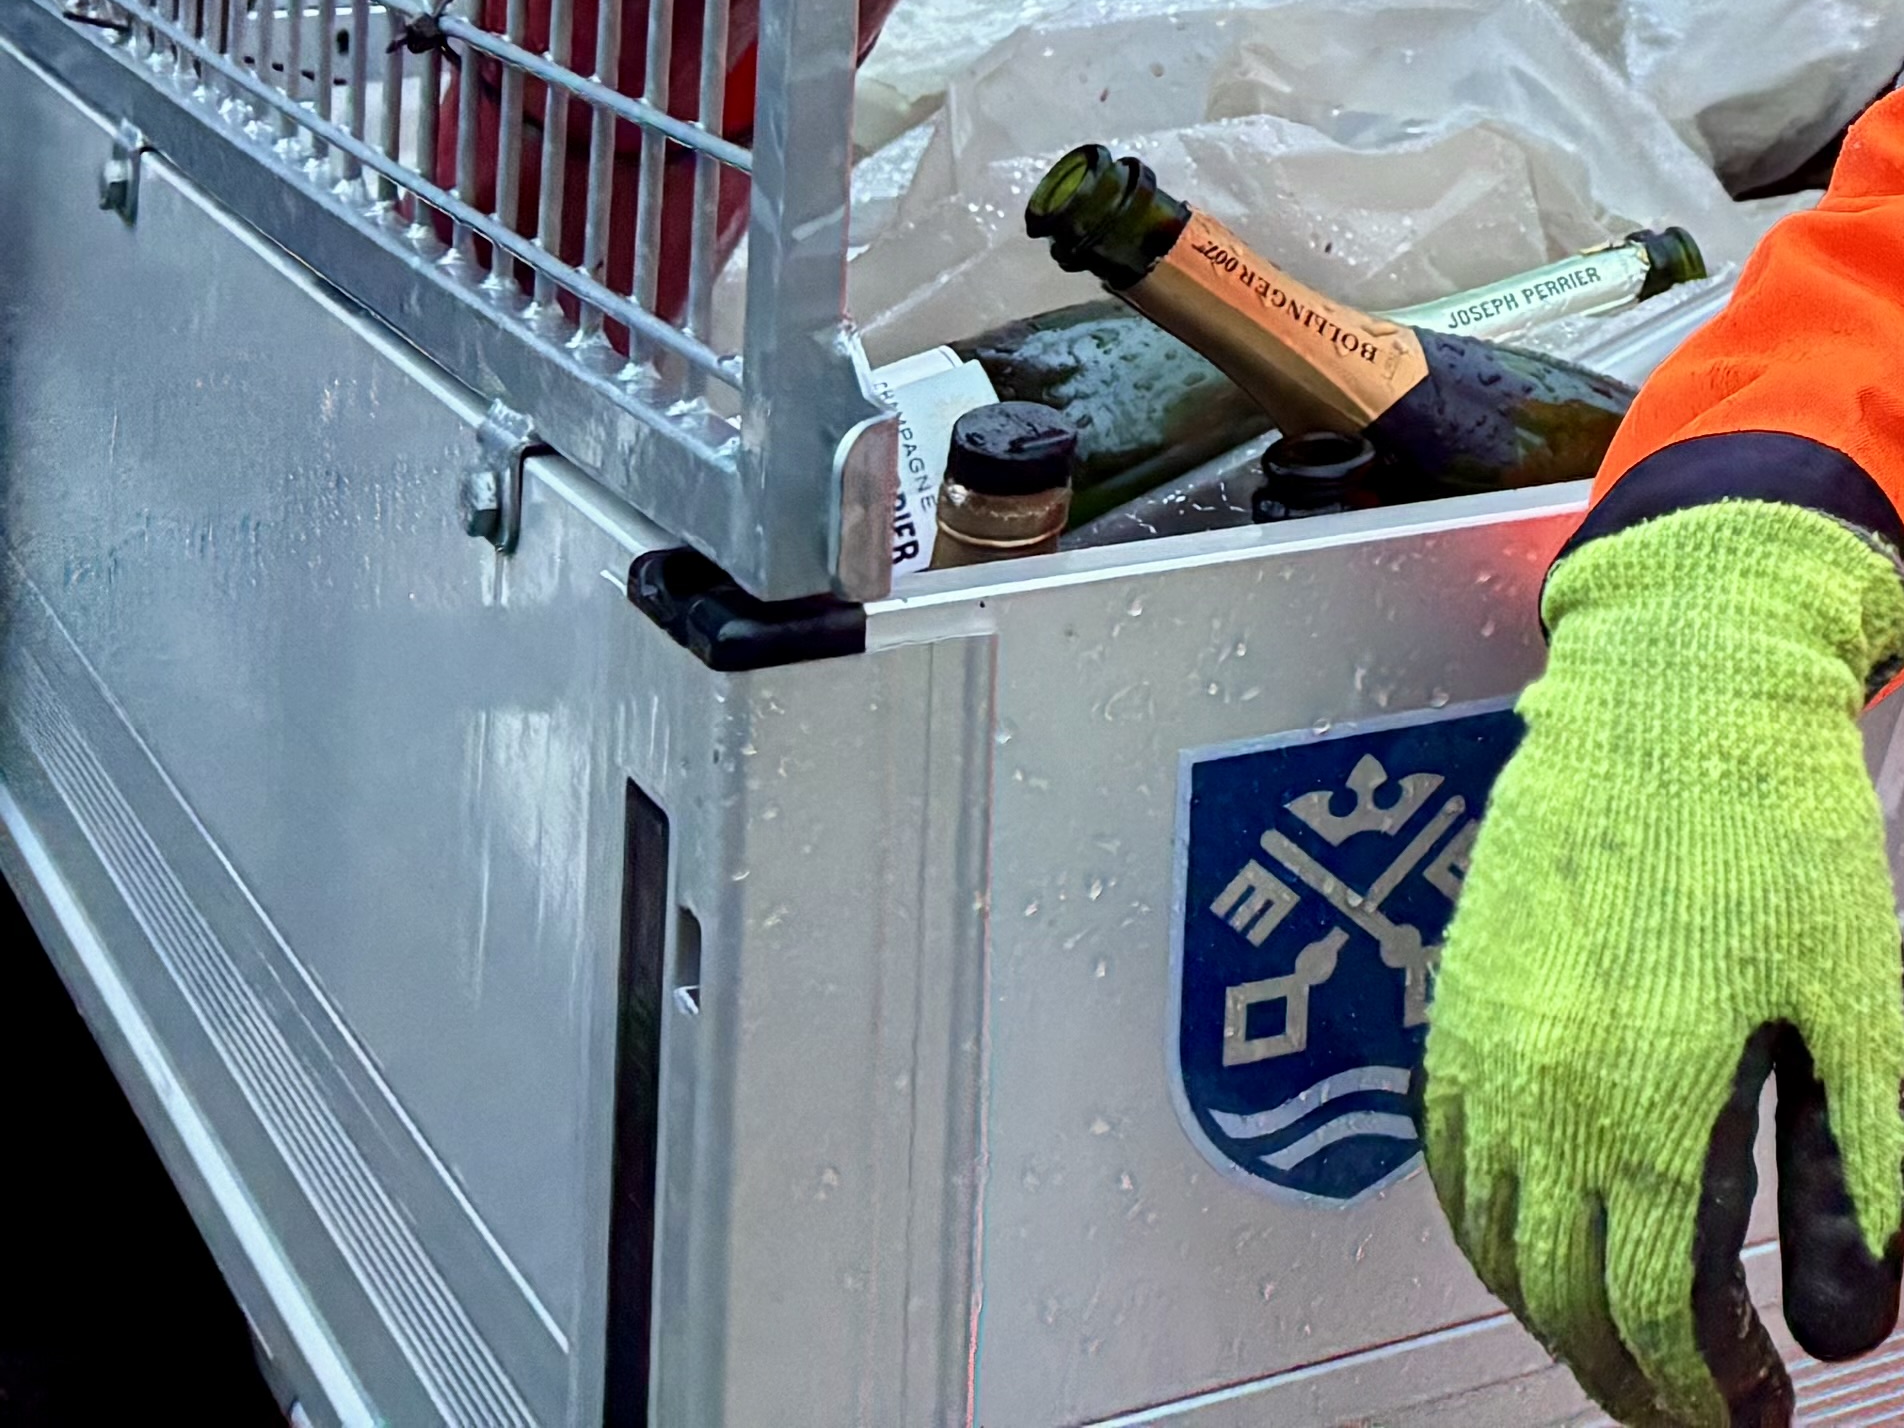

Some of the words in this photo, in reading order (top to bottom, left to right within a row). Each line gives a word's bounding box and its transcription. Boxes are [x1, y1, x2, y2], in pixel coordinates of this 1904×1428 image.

[1233, 264, 1379, 365] BOLLINGER
[1447, 292, 1519, 329] JOSEPH
[1521, 266, 1602, 305] PERRIER
